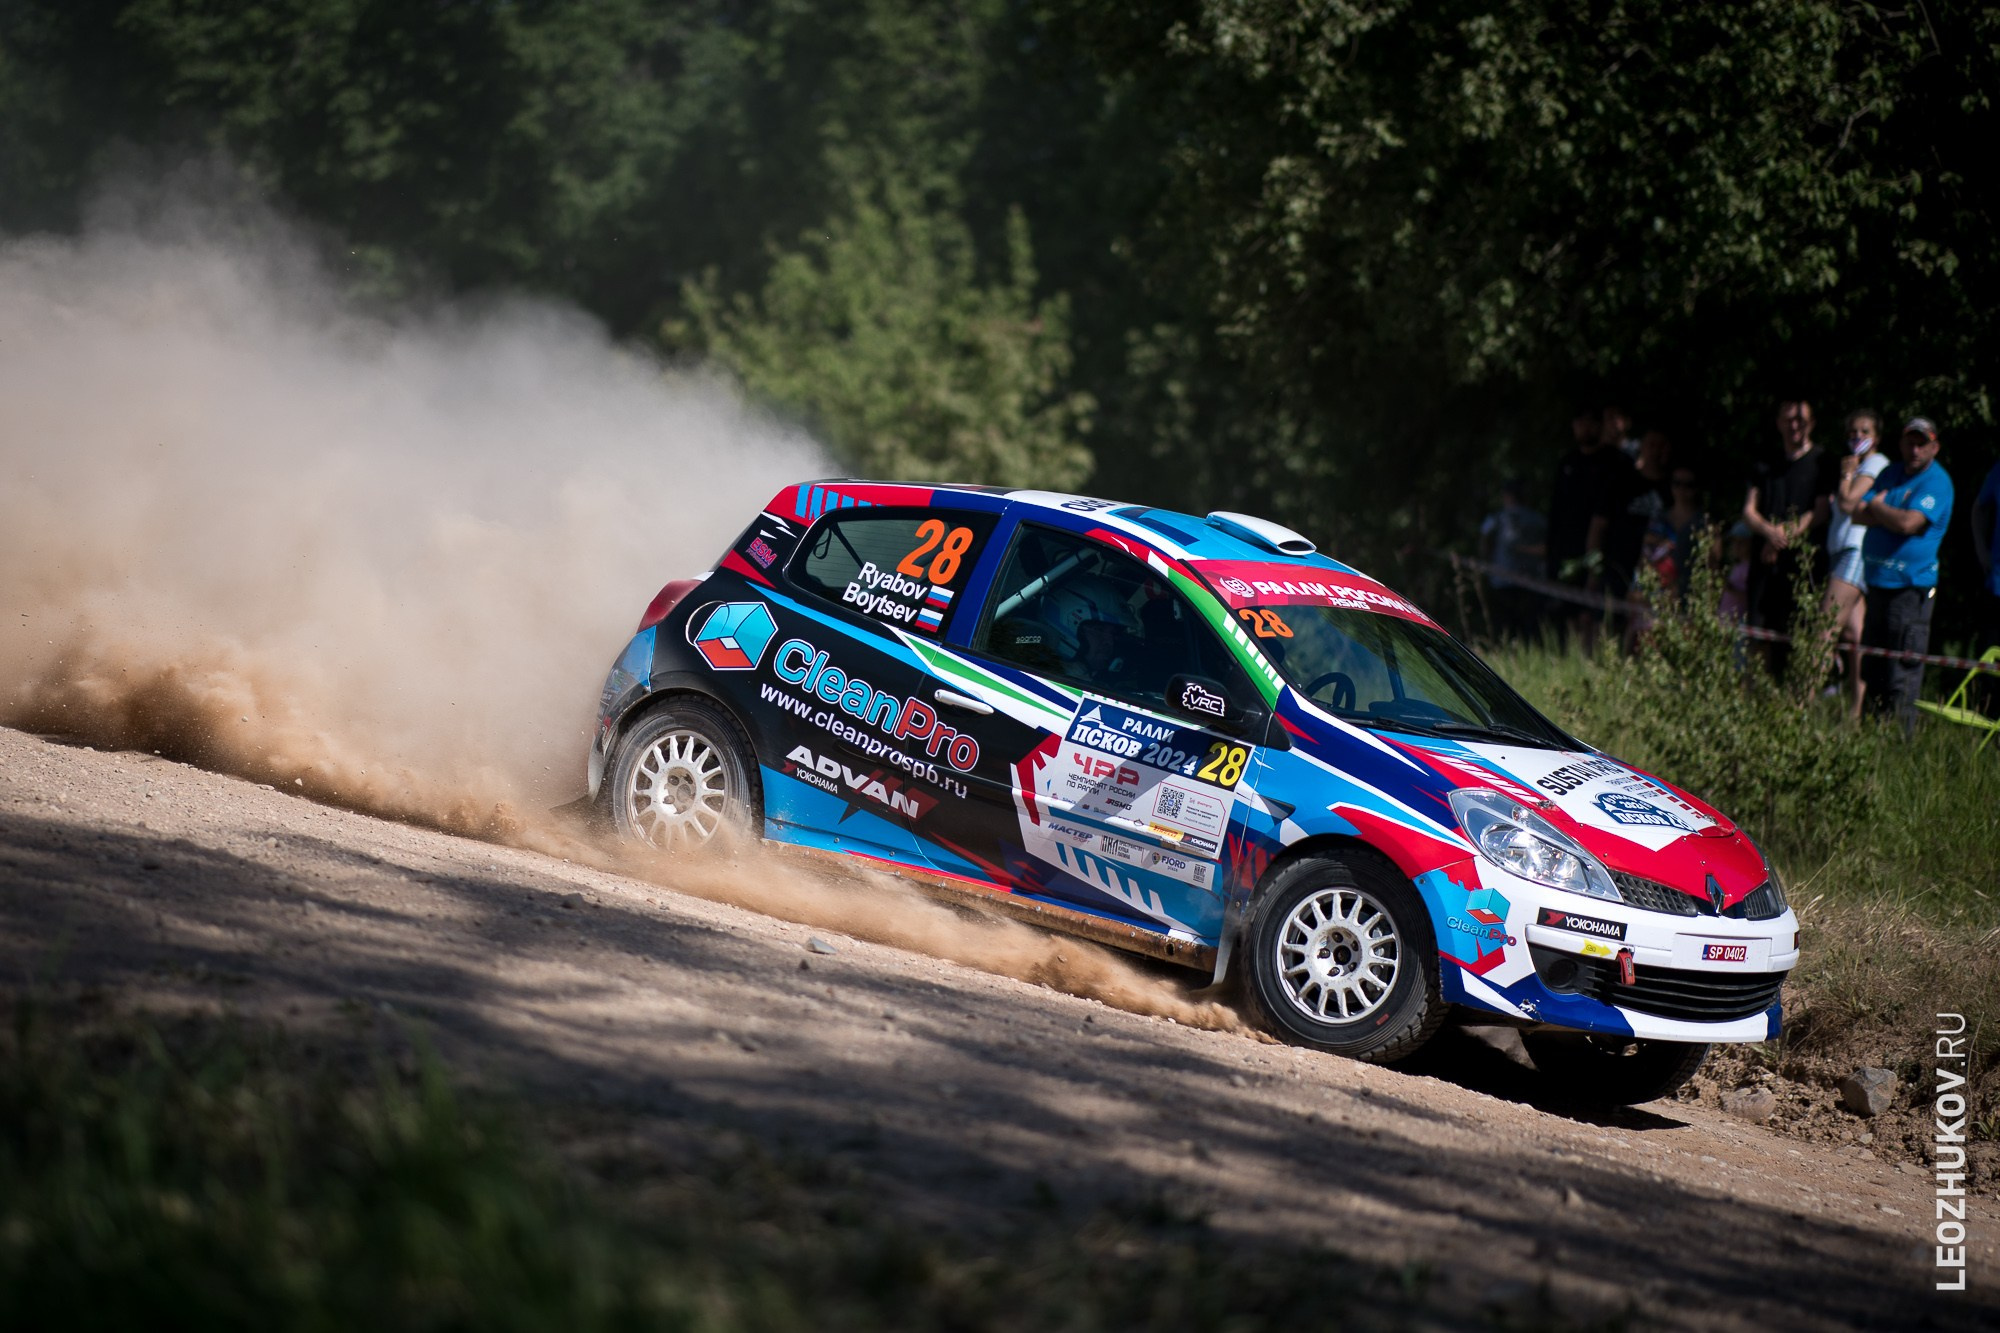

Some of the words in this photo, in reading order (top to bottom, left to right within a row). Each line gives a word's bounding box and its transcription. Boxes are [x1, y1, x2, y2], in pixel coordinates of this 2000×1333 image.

[896, 519, 973, 585] 28
[858, 562, 927, 600] Ryabov
[1252, 581, 1334, 597] РАЛЛИ
[842, 582, 917, 622] Boytsev
[1239, 609, 1294, 638] 28
[774, 638, 979, 771] CleanPro
[1190, 694, 1221, 712] VRC
[1121, 717, 1175, 743] РАЛЛИ
[1071, 724, 1143, 758] ПСКОВ
[1142, 743, 1198, 776] 2024
[1197, 742, 1247, 787] 28
[786, 745, 919, 818] ADVAN
[796, 767, 838, 794] YOKOHAMA
[1066, 780, 1076, 788] ПО
[1077, 783, 1100, 796] РАЛЛИ
[1068, 772, 1107, 790] ЧЕМПИОНАТ
[1109, 785, 1136, 799] РОССИИ
[1048, 822, 1093, 839] МАСТЕР
[1613, 812, 1670, 826] ПСКОВ
[1191, 837, 1216, 850] YOKOHAMA
[1161, 856, 1186, 869] FJORD
[1446, 916, 1517, 946] CleanPro
[1565, 916, 1621, 936] YOKOHAMA
[1709, 946, 1723, 959] SP
[1724, 947, 1745, 960] 0402
